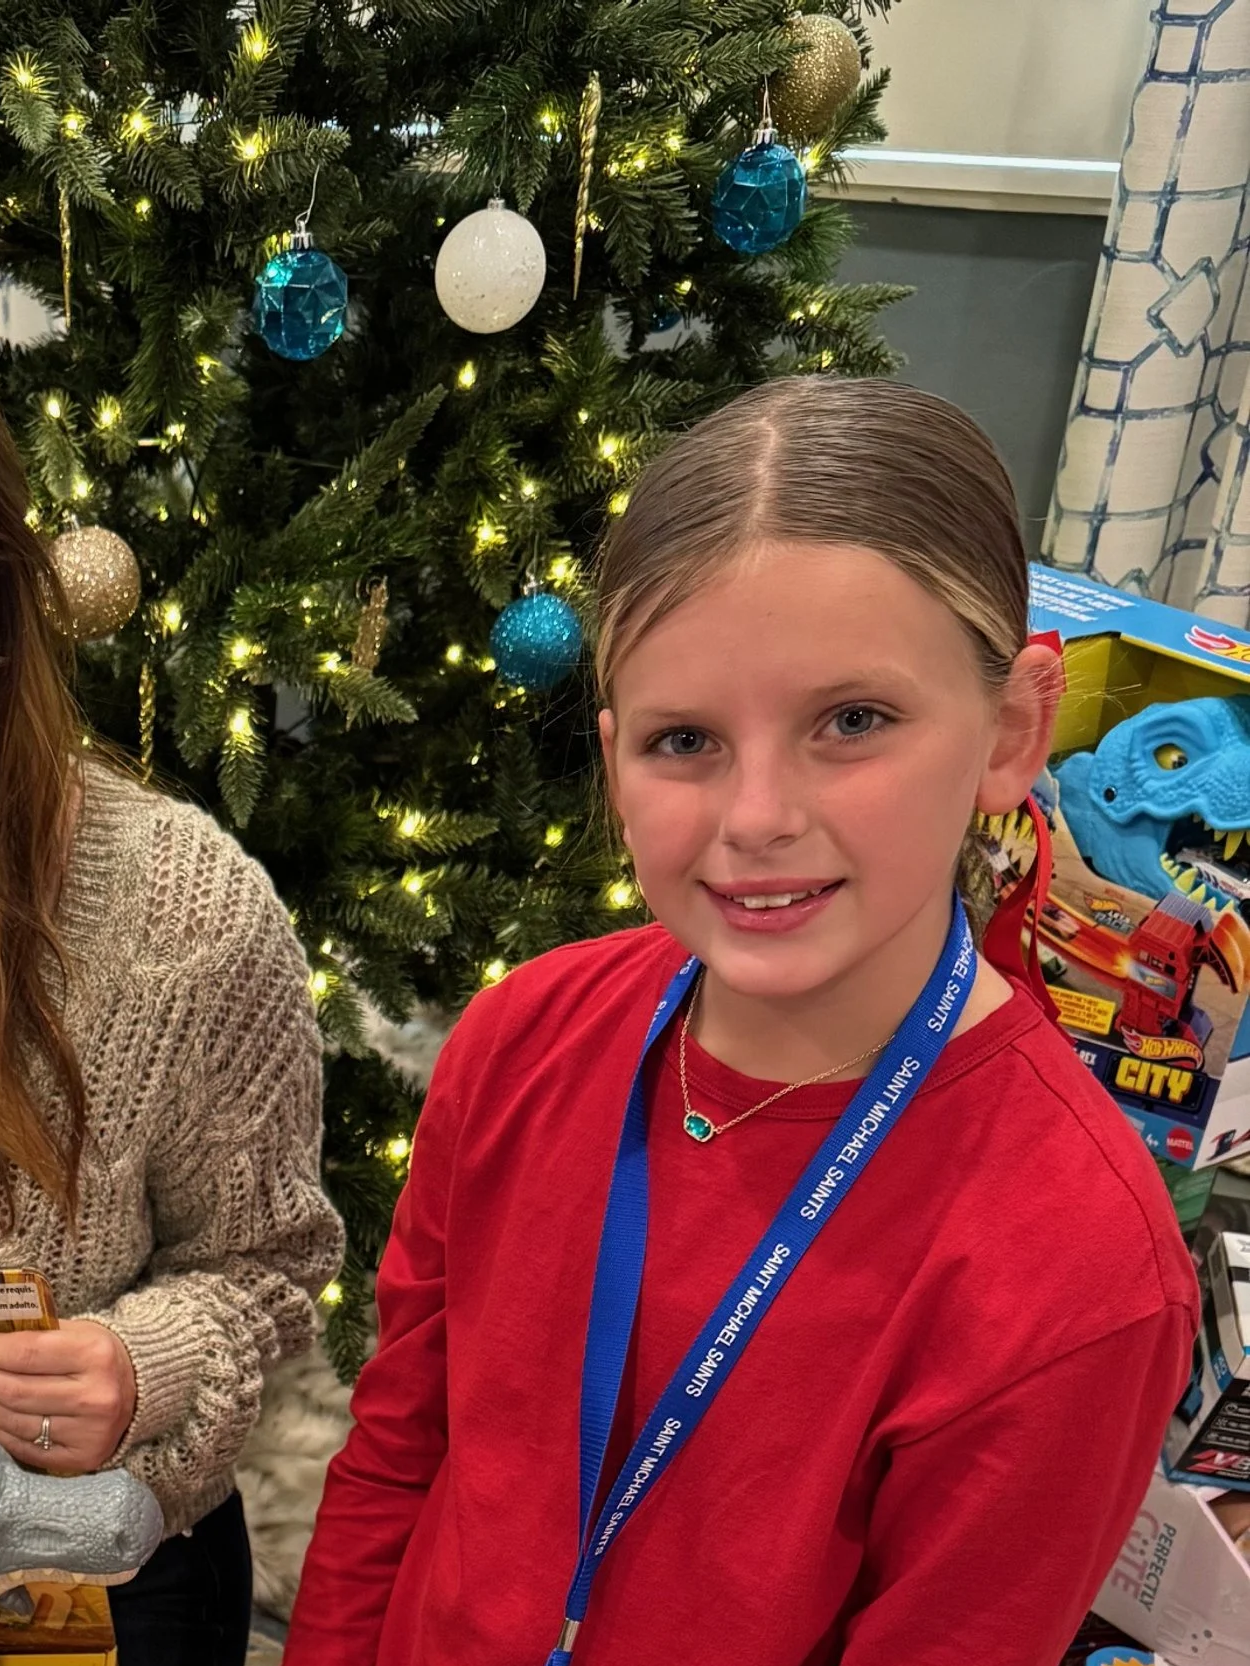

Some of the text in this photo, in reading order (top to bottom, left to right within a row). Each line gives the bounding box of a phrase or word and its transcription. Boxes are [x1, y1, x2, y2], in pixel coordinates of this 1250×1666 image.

[1115, 1056, 1193, 1103] CITY
[799, 1055, 921, 1221] SAINT MICHAEL SAINTS
[685, 1243, 791, 1399] SAINT MICHAEL SAINTS
[650, 1416, 681, 1458] SAINT
[617, 1456, 656, 1510] MICHAEL
[1137, 1522, 1177, 1614] PERFECTLY
